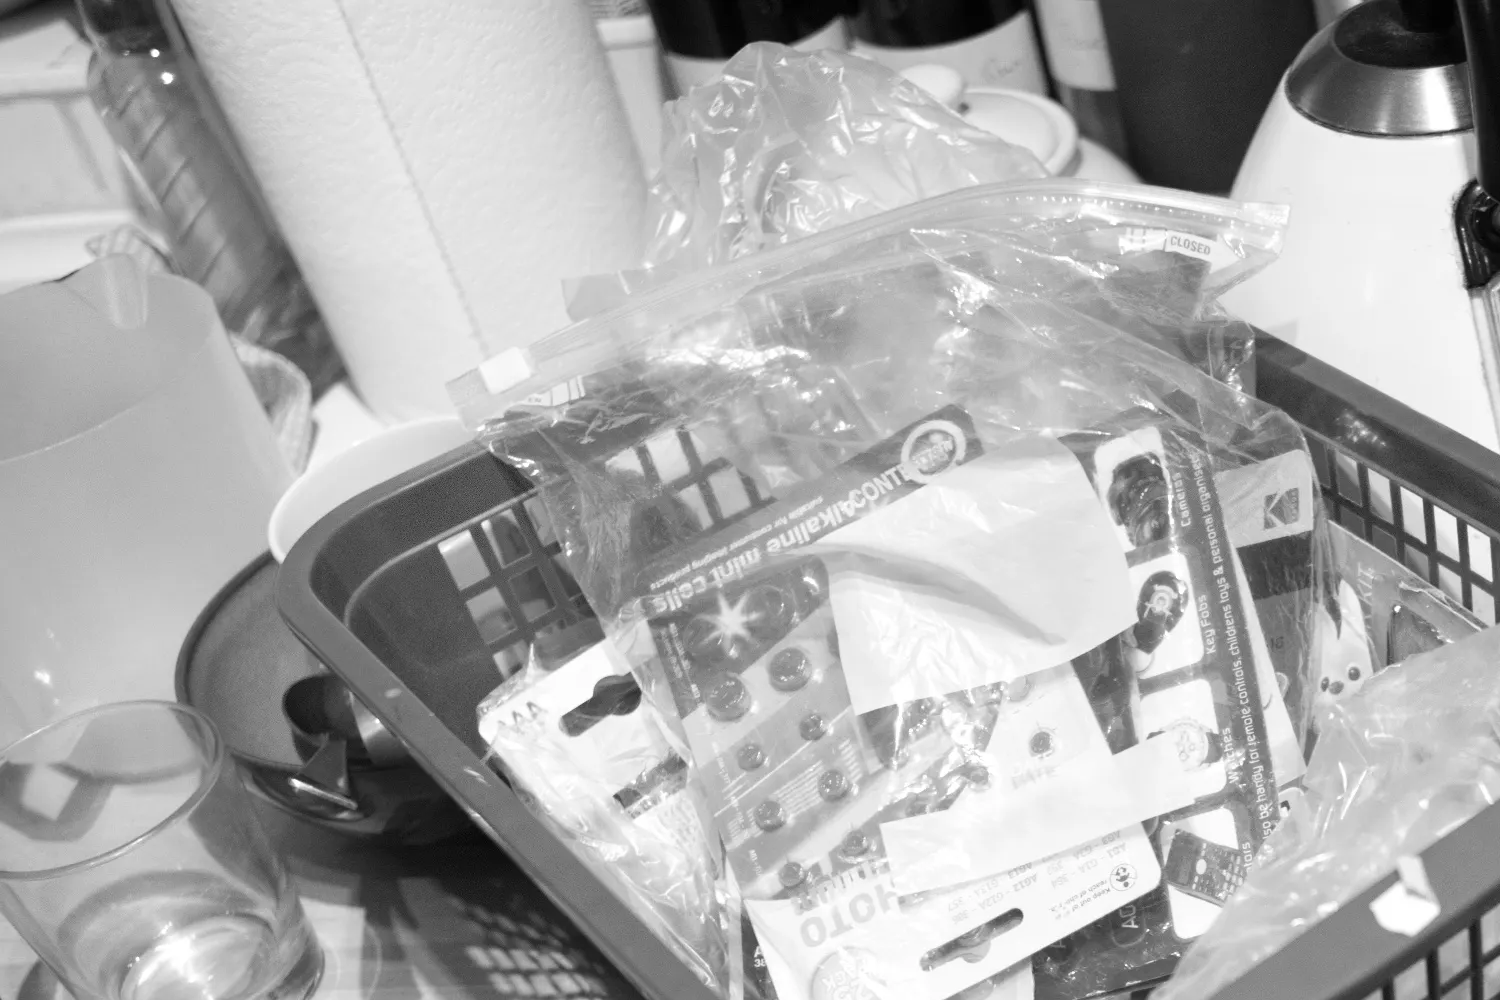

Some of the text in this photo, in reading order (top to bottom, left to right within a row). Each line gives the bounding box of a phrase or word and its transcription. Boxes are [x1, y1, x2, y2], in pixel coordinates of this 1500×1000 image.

[1170, 236, 1211, 256] CLOSED
[1174, 473, 1191, 526] Cameras
[762, 495, 860, 557] Alkaline
[1205, 514, 1224, 563] personal
[1212, 564, 1224, 576] &
[648, 572, 711, 617] cells
[1216, 576, 1231, 602] toys
[1198, 594, 1218, 653] Key Fobs
[1222, 604, 1241, 655] childrens
[1231, 657, 1252, 704] controls,
[1243, 707, 1258, 746] remote
[1248, 748, 1259, 763] for
[1252, 765, 1270, 802] handy
[1259, 803, 1271, 819] be
[1011, 873, 1039, 892] AG12
[1070, 885, 1111, 912] Keep out of
[1077, 889, 1088, 898] of
[1087, 878, 1107, 893] reach
[800, 884, 892, 947] HOTO
[977, 890, 1005, 910] G12A
